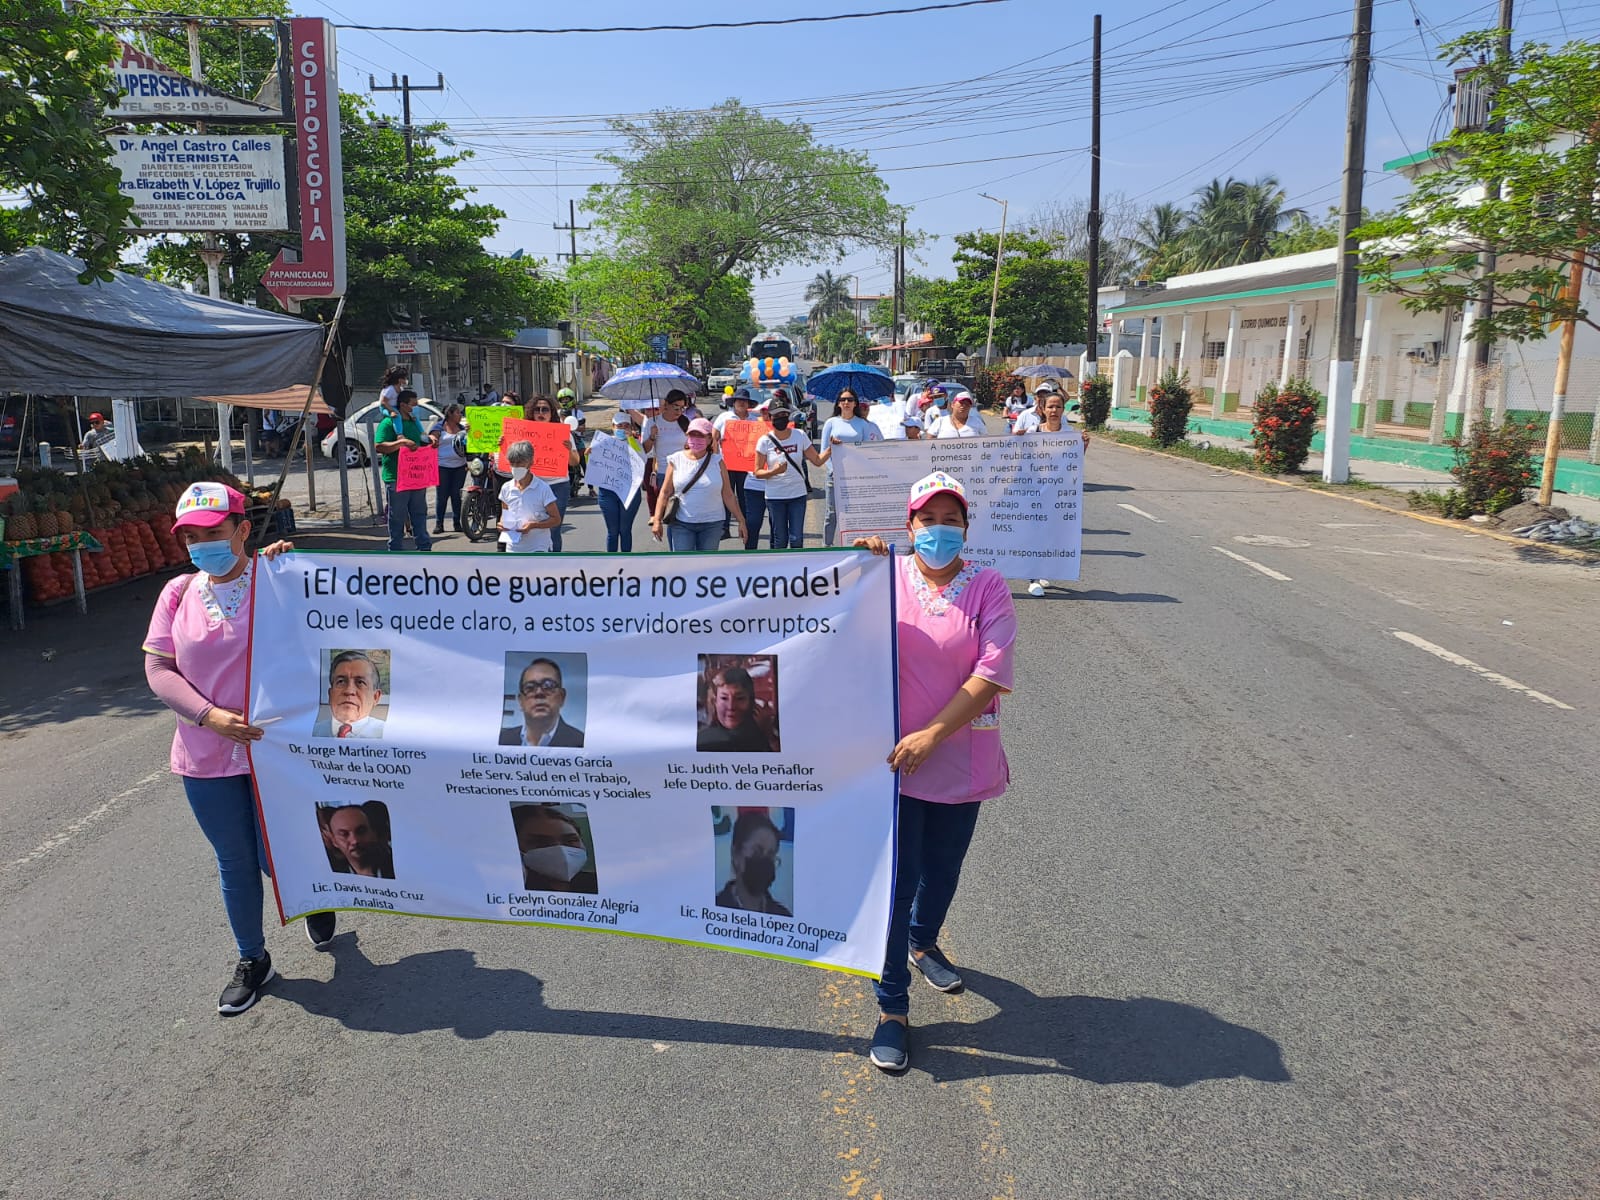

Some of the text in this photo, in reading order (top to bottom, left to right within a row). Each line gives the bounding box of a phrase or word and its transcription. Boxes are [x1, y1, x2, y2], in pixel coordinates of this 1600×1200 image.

[120, 139, 270, 153] Dr. Angel Castro Calles
[300, 41, 326, 240] COLPOSCOPIA
[152, 154, 239, 162] INTERNISTA
[193, 180, 204, 190] V.
[206, 179, 240, 192] López
[244, 179, 280, 192] Trujillo
[941, 442, 978, 450] nosotros
[982, 440, 1018, 449] también
[1023, 440, 1038, 448] nos
[1043, 439, 1078, 448] hicieron
[931, 454, 972, 463] promesas
[981, 452, 992, 460] de
[1001, 451, 1052, 460] reubicación,
[1030, 464, 1058, 472] fuente
[1066, 463, 1078, 472] de
[989, 476, 1032, 484] ofrecieron
[1037, 477, 1064, 486] apoyo
[1004, 488, 1040, 496] llamaron
[990, 500, 1019, 510] trabajo
[991, 512, 1076, 522] dependientes del
[992, 524, 1015, 532] IMSS.
[977, 547, 994, 555] esta
[996, 548, 1006, 556] su
[1009, 548, 1076, 558] responsabilidad
[304, 566, 840, 602] ¡El derecho de guardería no se vende!
[306, 610, 836, 638] Que les quede claro, a estos servidores corruptos.
[289, 744, 426, 760] Dr. Jorge Martínez Torres
[311, 760, 411, 775] Titular de la OOAD
[472, 753, 612, 768] Lic. David Cuevas García
[668, 764, 814, 776] Lic. Judith Vela Peñaflor
[323, 774, 404, 790] Veracruz Norte
[460, 769, 631, 786] Jefe Serv. Salud en el Trabajo,
[446, 784, 651, 800] Prestaciones Económicas y Sociales
[664, 778, 824, 792] Jefe Depto. de Guarderías
[312, 882, 424, 900] Lic. Davis Jurado Cruz
[353, 897, 394, 910] Analista
[486, 893, 504, 904] Lic.
[508, 894, 544, 906] Evelyn
[548, 894, 597, 908] González
[510, 906, 618, 925] Coordinadora Zonal
[680, 905, 847, 942] Lic. Rosa Isela López Oropeza
[706, 923, 818, 952] Coordinadora Zonal
